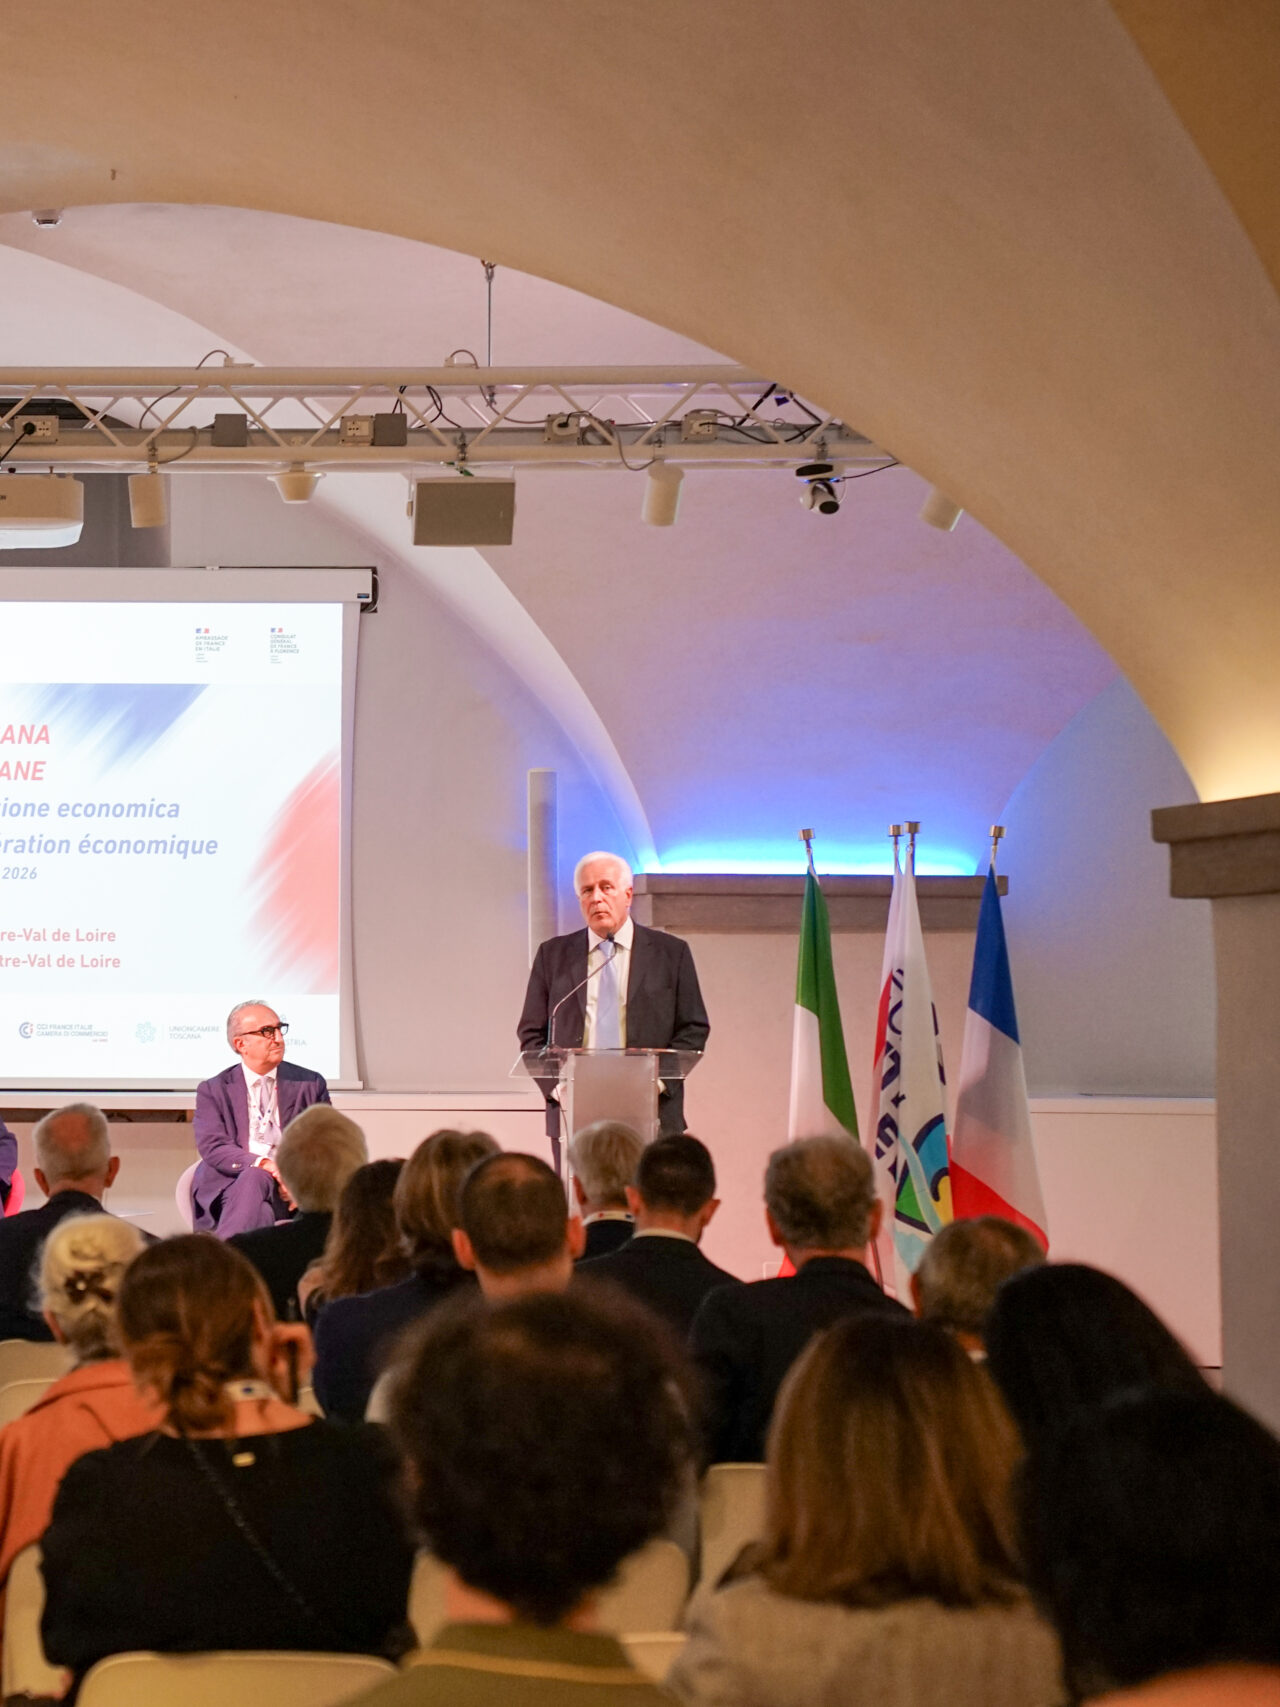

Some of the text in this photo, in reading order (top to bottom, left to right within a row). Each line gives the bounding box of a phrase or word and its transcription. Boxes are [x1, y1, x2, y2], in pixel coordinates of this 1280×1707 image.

[57, 797, 181, 819] economica
[77, 832, 219, 860] économique
[1, 866, 38, 880] 2026
[51, 927, 71, 943] de
[75, 927, 117, 943] Loire
[55, 953, 76, 969] de
[80, 953, 121, 969] Loire
